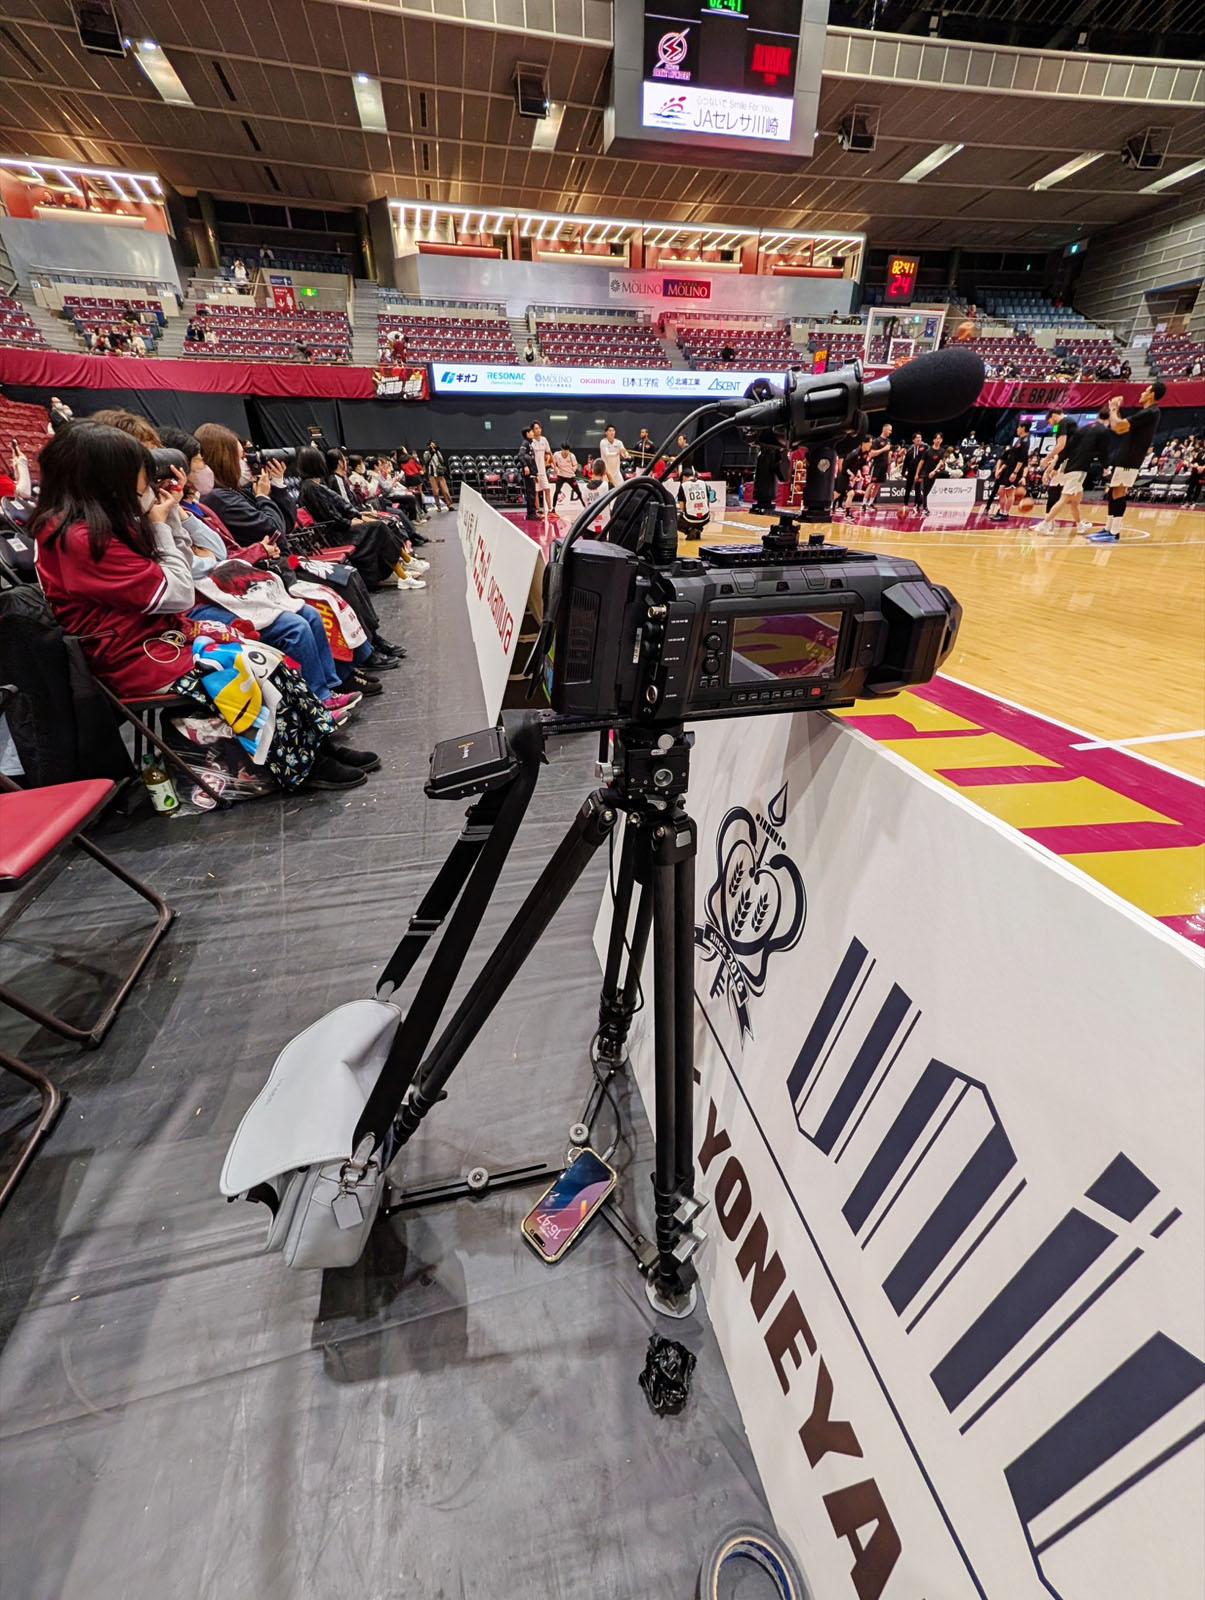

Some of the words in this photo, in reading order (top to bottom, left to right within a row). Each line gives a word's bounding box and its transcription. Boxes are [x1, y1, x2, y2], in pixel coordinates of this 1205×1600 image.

[693, 108, 779, 137] JAセレサ川崎
[622, 281, 662, 295] MOLINO
[667, 281, 708, 298] MOLINO
[888, 275, 912, 297] 24
[456, 373, 478, 384] ギオン
[487, 371, 526, 381] RESONAC
[541, 374, 572, 384] MOLINO
[622, 377, 659, 388] 日本工学院
[708, 378, 742, 391] ASCENT
[709, 931, 728, 956] since
[726, 953, 745, 993] 2016
[536, 1213, 562, 1240] 15:47
[697, 1095, 926, 1600] YONEYA
